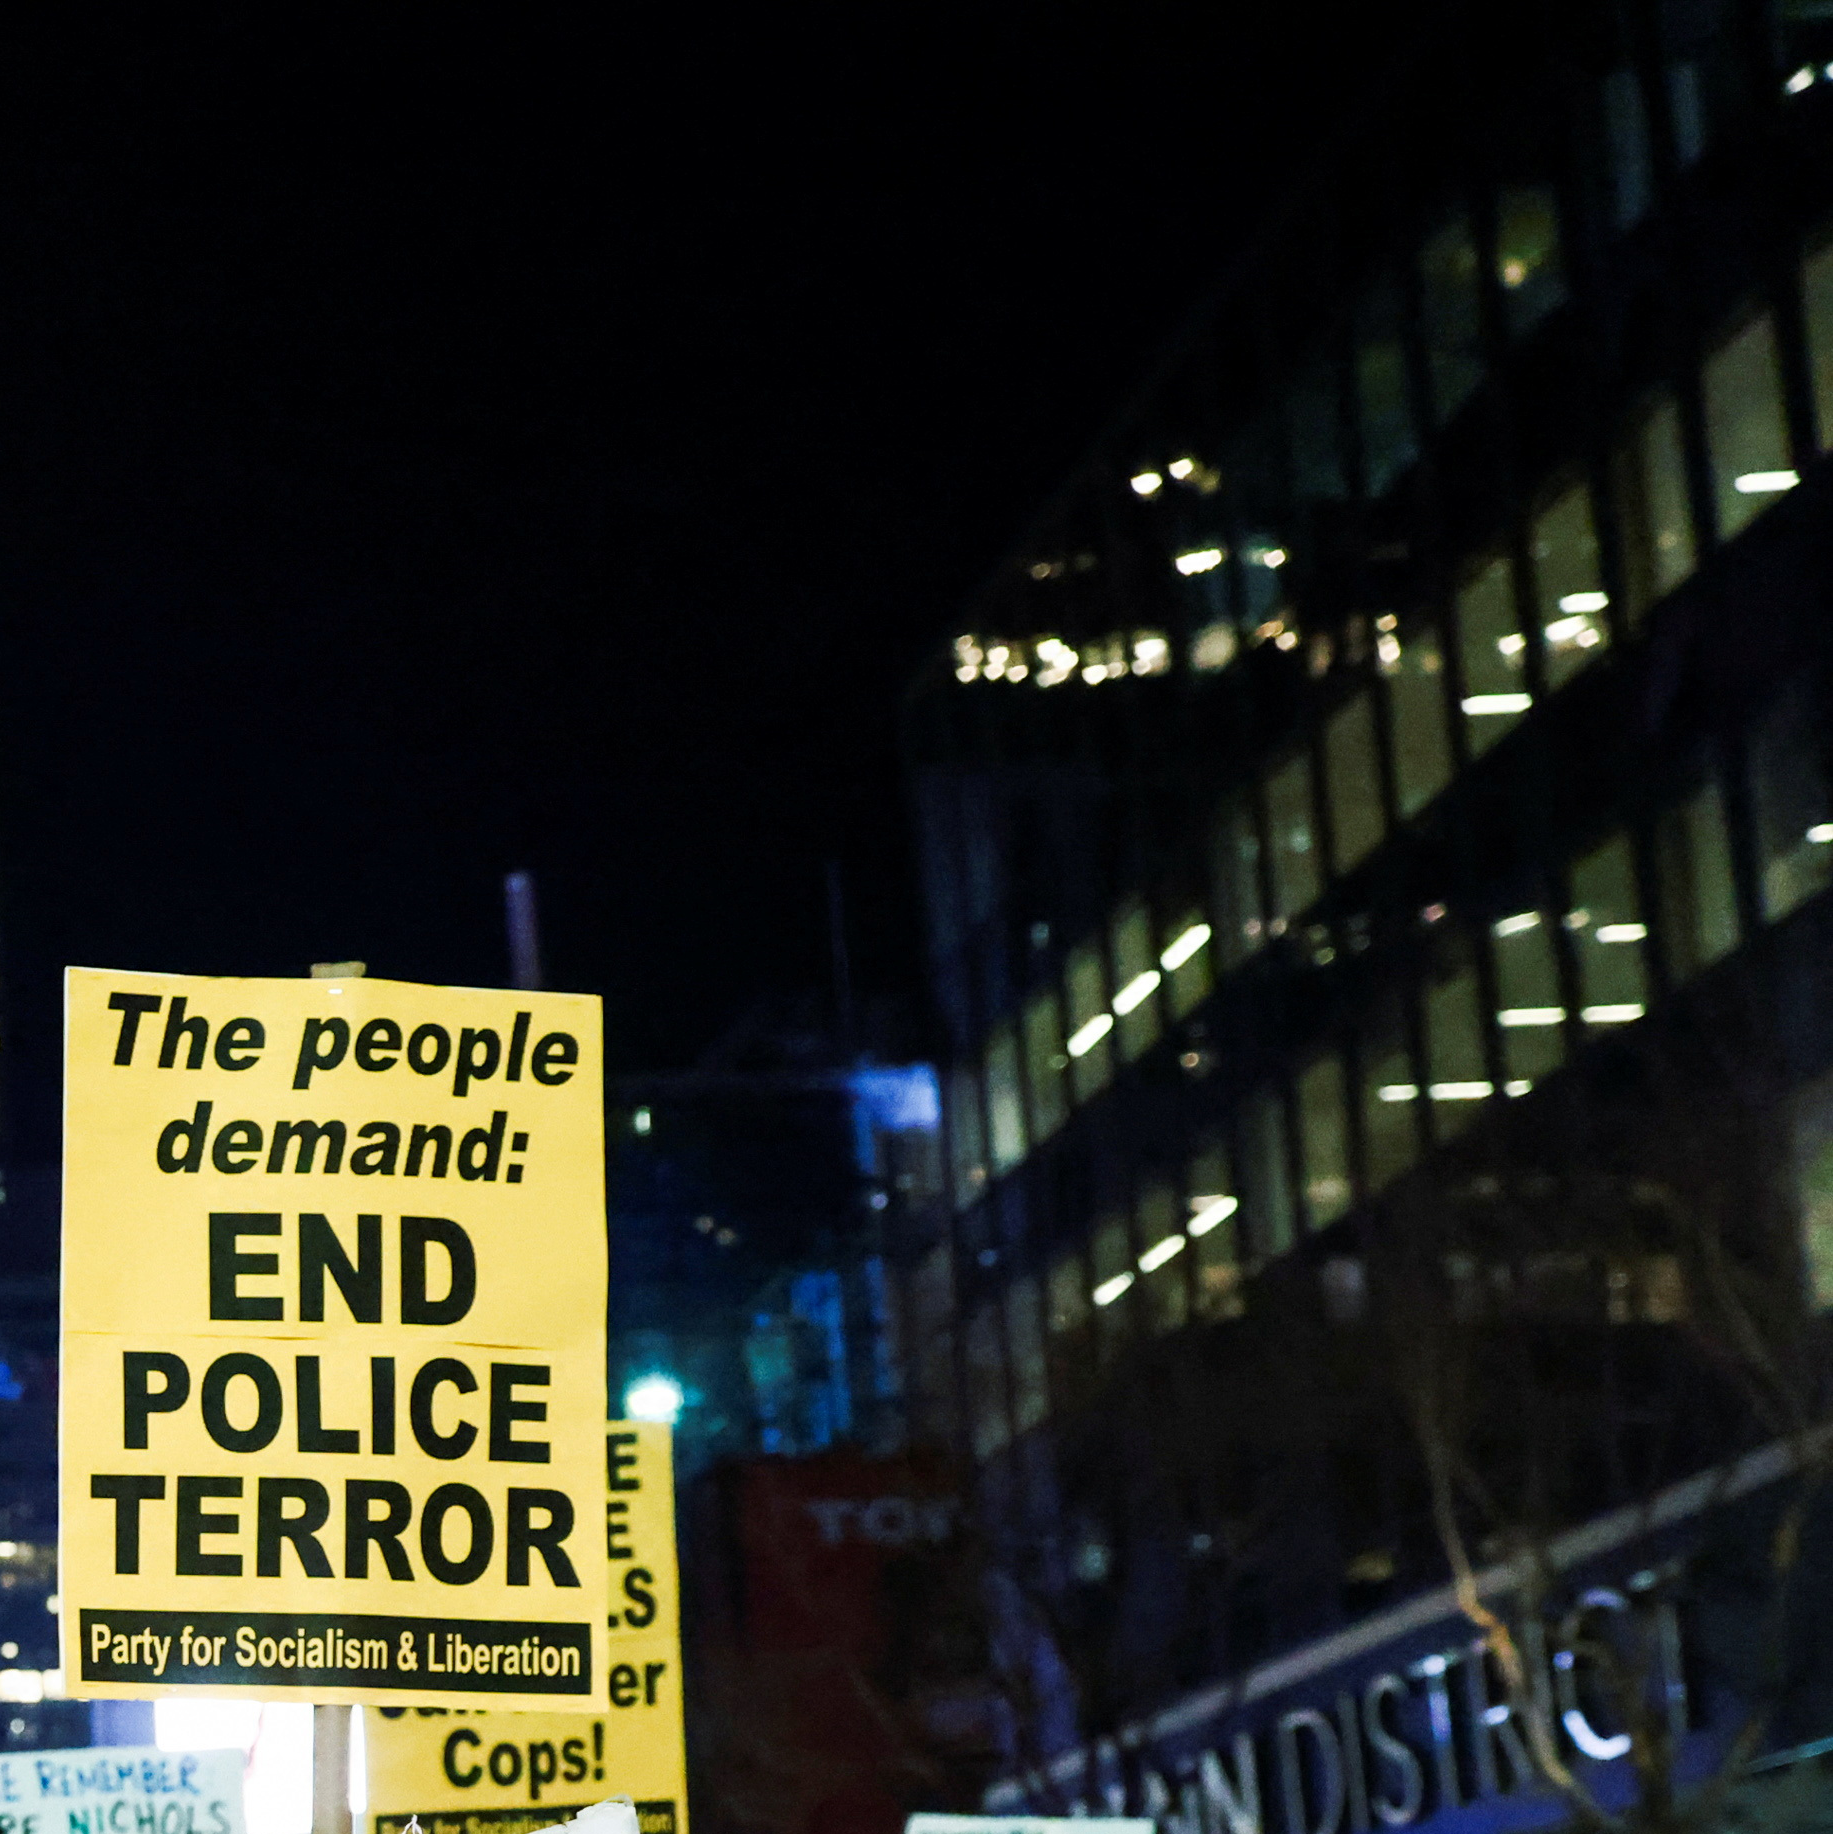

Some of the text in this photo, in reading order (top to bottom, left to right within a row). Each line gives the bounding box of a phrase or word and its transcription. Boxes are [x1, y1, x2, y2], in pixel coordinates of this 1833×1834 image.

[108, 992, 578, 1097] The people
[157, 1101, 529, 1183] demand:
[209, 1213, 476, 1325] END
[123, 1351, 550, 1464] POLICE
[91, 1474, 581, 1587] TERROR
[92, 1624, 579, 1676] Party for Socialism & Liberation
[443, 1722, 605, 1799] Cops!
